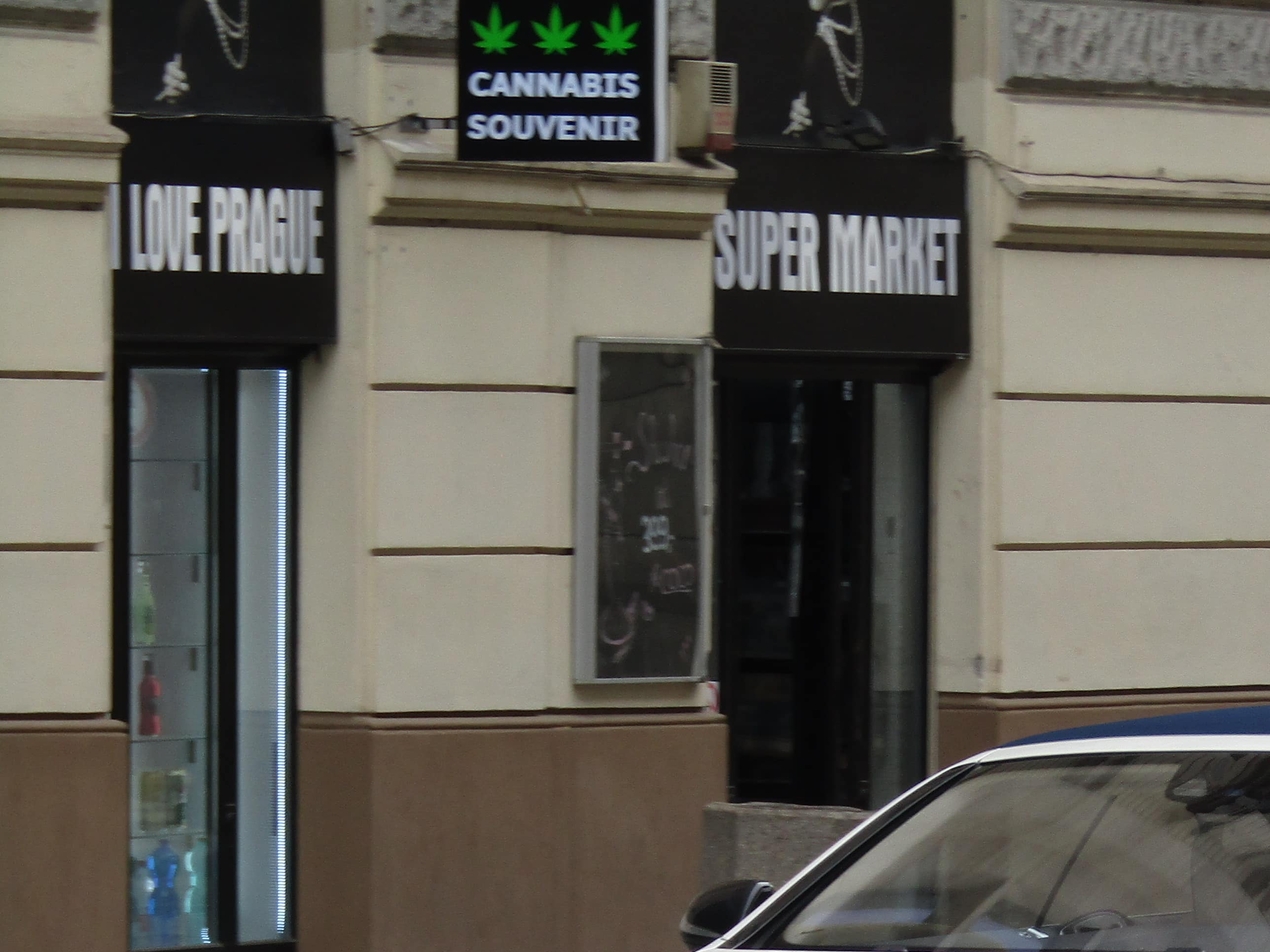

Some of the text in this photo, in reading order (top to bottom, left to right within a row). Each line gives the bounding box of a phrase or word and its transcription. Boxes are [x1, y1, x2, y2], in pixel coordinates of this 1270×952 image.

[467, 71, 640, 99] CANNABIS
[466, 114, 640, 141] SOUVENIR
[130, 183, 202, 272] LOVE
[208, 186, 324, 275] PRAGUE
[714, 209, 961, 296] SUPER MARKET
